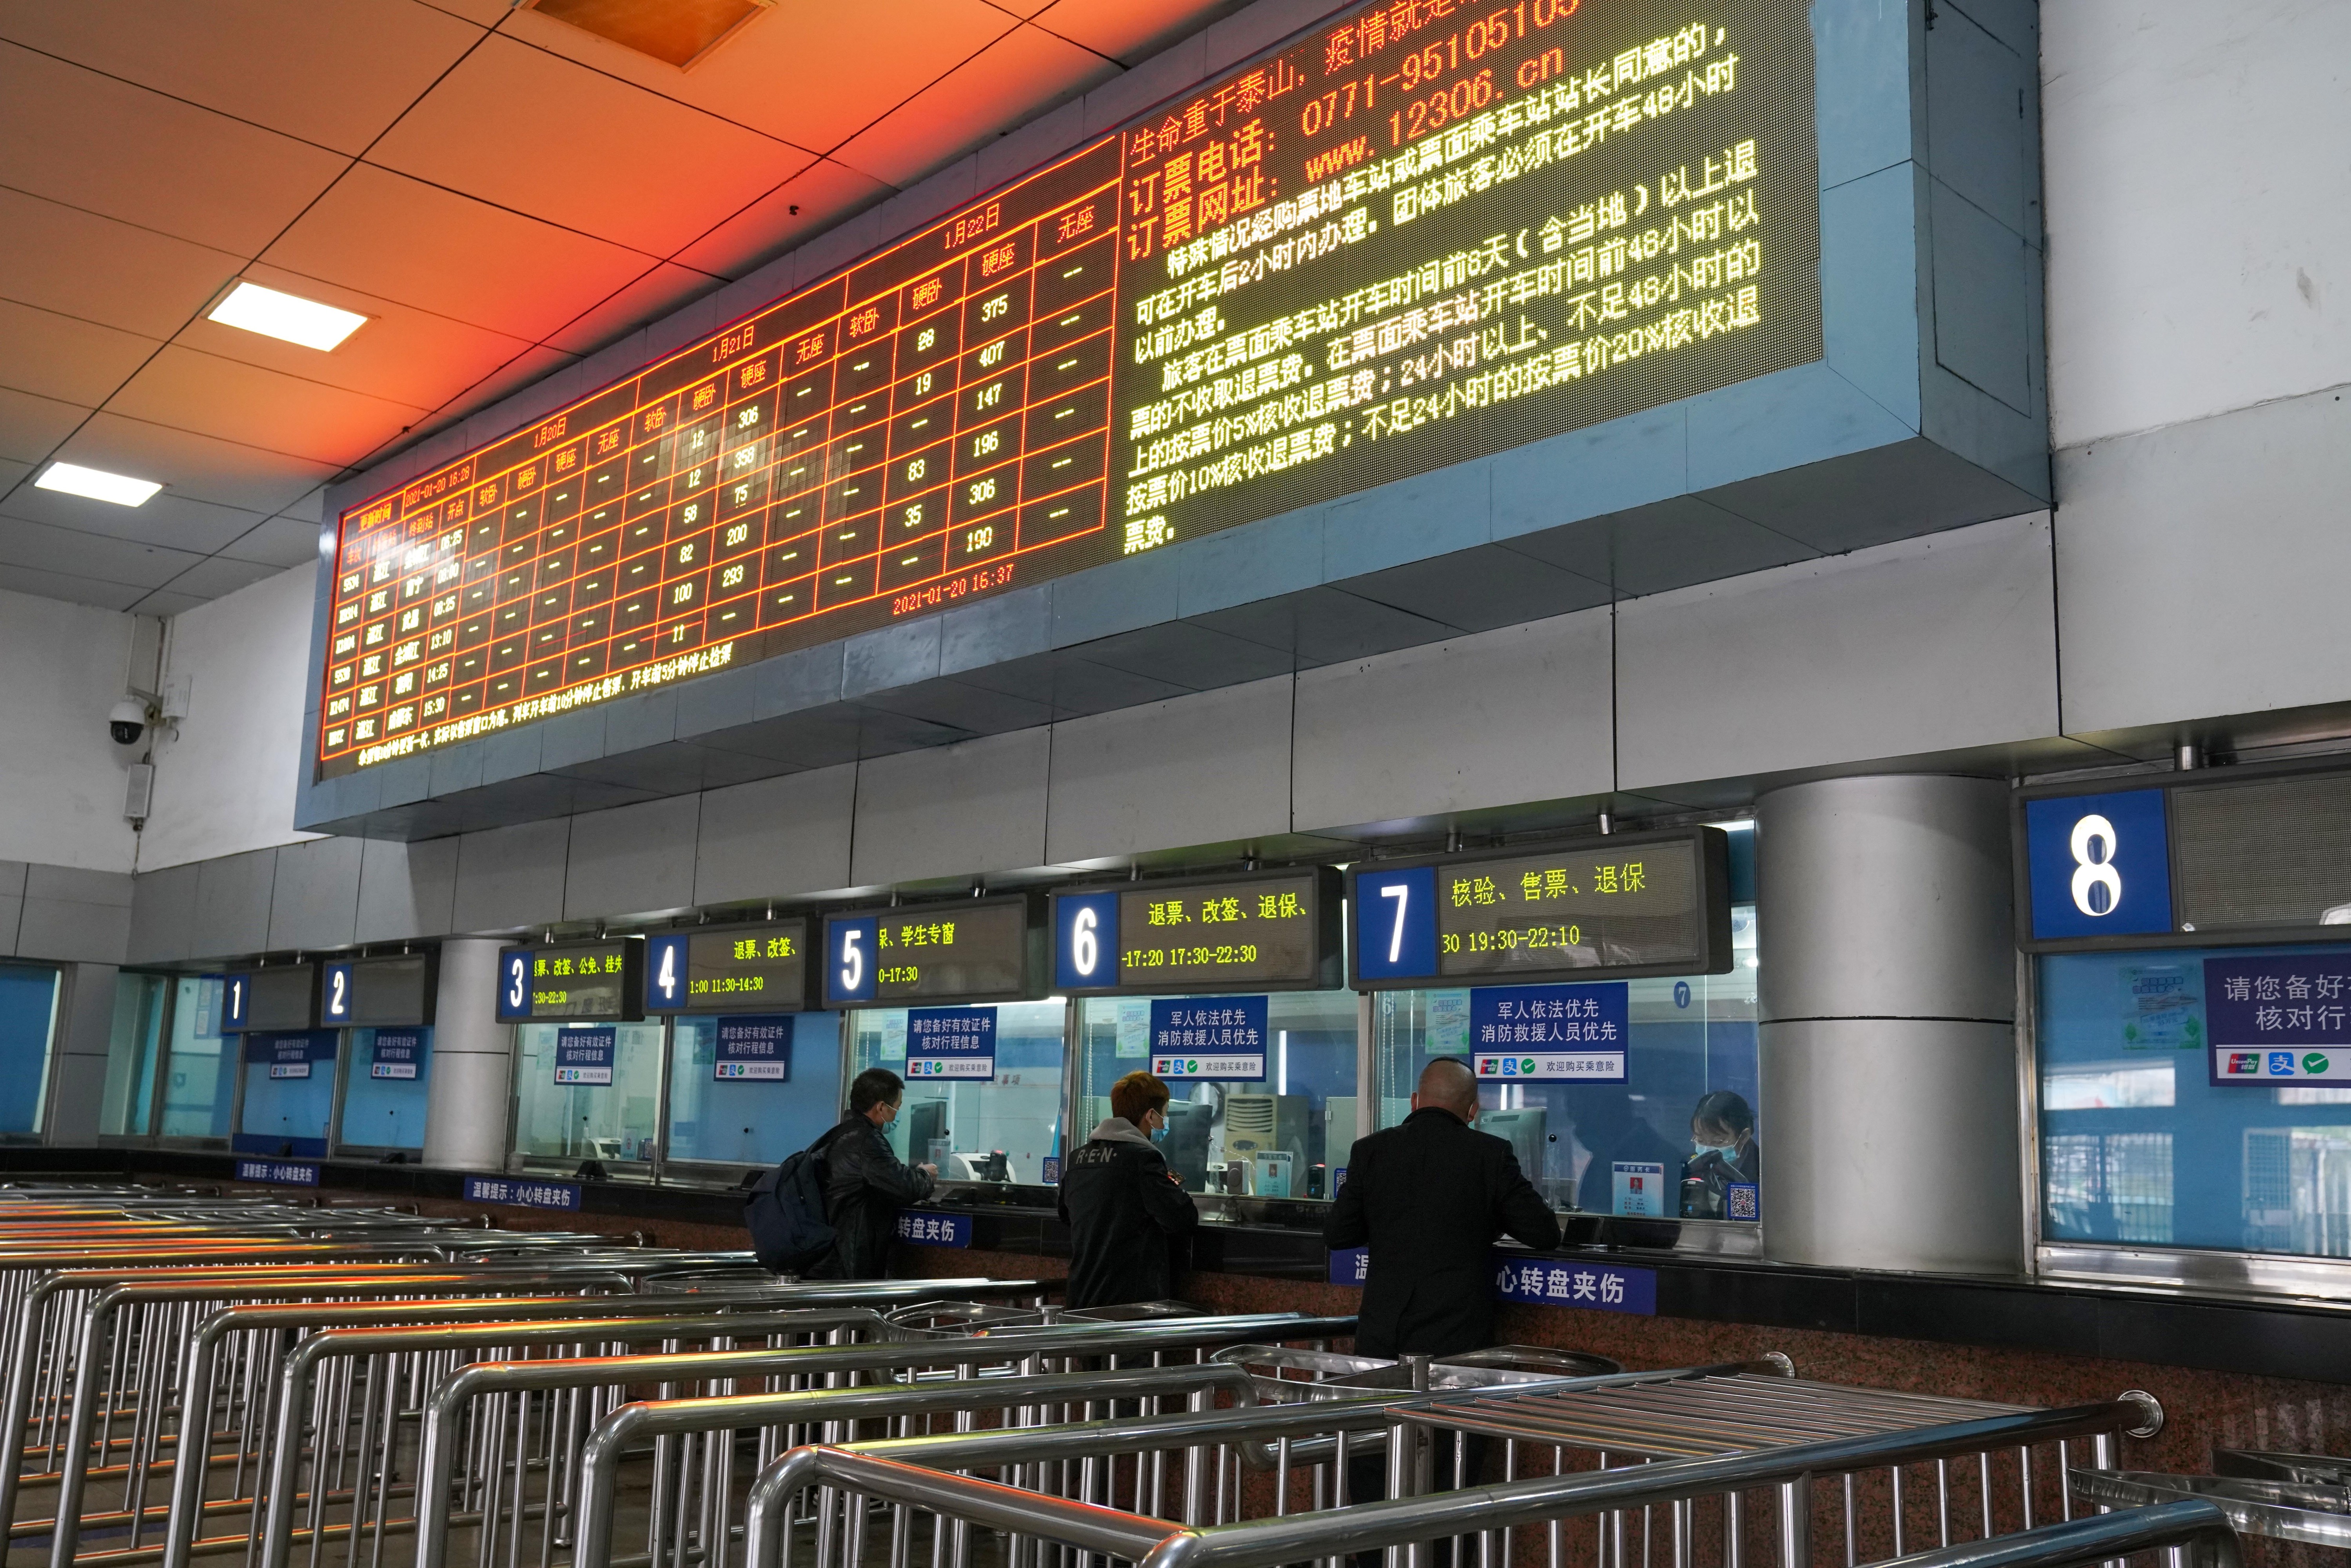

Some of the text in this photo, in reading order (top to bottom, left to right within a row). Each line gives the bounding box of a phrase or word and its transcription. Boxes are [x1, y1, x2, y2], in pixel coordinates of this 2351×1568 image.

[1129, 119, 1275, 216] 订票电话：
[945, 203, 1000, 249] 1月22日
[1127, 165, 1277, 260] 订票网址：
[850, 205, 1095, 338] 软卧 硬卧 硬座 无座
[712, 325, 755, 363] 1月21日
[1134, 305, 1225, 365] 以前办理。
[644, 333, 825, 432] 软卧 硬卧 硬座 无座
[692, 429, 704, 449] 12
[738, 405, 759, 429] 306
[917, 328, 935, 352] 28
[982, 294, 1008, 322] 375
[534, 416, 567, 448] 1月20日
[688, 468, 701, 488] 12
[734, 446, 755, 468] 358
[916, 373, 931, 396] 19
[979, 341, 1005, 367] 407
[479, 428, 620, 507] 软卧 硬卧 硬座 无座
[359, 465, 470, 533] 更新时间 2021-01-20 16:28
[434, 595, 456, 617] 08:25
[683, 504, 697, 524] 58
[735, 484, 749, 504] 75
[977, 383, 1002, 410] 147
[447, 498, 465, 521] 开点
[431, 629, 452, 650] 13:10
[679, 543, 693, 563] 82
[726, 524, 747, 546] 200
[908, 459, 925, 482] 83
[973, 430, 998, 457] 196
[1124, 515, 1175, 554] 票费。
[427, 662, 449, 684] 14:25
[673, 583, 693, 604] 100
[722, 564, 744, 588] 293
[905, 504, 922, 527] 35
[969, 478, 995, 505] 306
[893, 564, 1015, 616] 2021-01-20 16:37
[423, 697, 445, 717] 15:30
[672, 623, 684, 643] 11
[966, 526, 993, 552] 190
[2071, 814, 2121, 916] 8
[1451, 862, 1646, 908] 核验、售票、退保
[1148, 893, 1306, 926] 退票、改签、退保、
[1381, 885, 1408, 963] 7
[733, 936, 796, 960] 退票、改签、
[1073, 908, 1097, 976] 6
[1170, 945, 1257, 965] 17:30-22:30
[1469, 926, 1579, 951] 19:30-22:10
[658, 946, 675, 998] 4
[842, 929, 862, 990] 5
[878, 966, 918, 983] 0-17:30
[233, 980, 241, 1019] 1
[331, 971, 345, 1014] 2
[510, 959, 523, 1007] 3
[533, 991, 567, 1004] :30-22:30
[690, 976, 764, 993] 1:00 11:30-14:30
[1677, 986, 1688, 1005] 7
[2224, 974, 2351, 1001] 请您备好
[913, 1017, 991, 1033] 请您备好有效证件
[1170, 1009, 1246, 1027] 军人依法优先
[1498, 999, 1599, 1020] 军人依法优先
[2256, 1005, 2351, 1031] 核对行
[721, 1025, 784, 1040] 请您备好有效证件
[728, 1041, 774, 1054] 核对行程信息
[922, 1034, 980, 1050] 核对行程信息
[1158, 1027, 1258, 1047] 消防救援人员优先
[1481, 1022, 1617, 1043] 消防救援人员优先
[1205, 1062, 1256, 1071] 欢迎购买乘意险
[1546, 1060, 1615, 1073] 欢迎购买乘意险
[2231, 1058, 2258, 1067] UnionPay
[473, 1181, 571, 1206] 温馨提示：小心转盘夹伤
[1496, 1265, 1625, 1304] 心转盘夹伤
